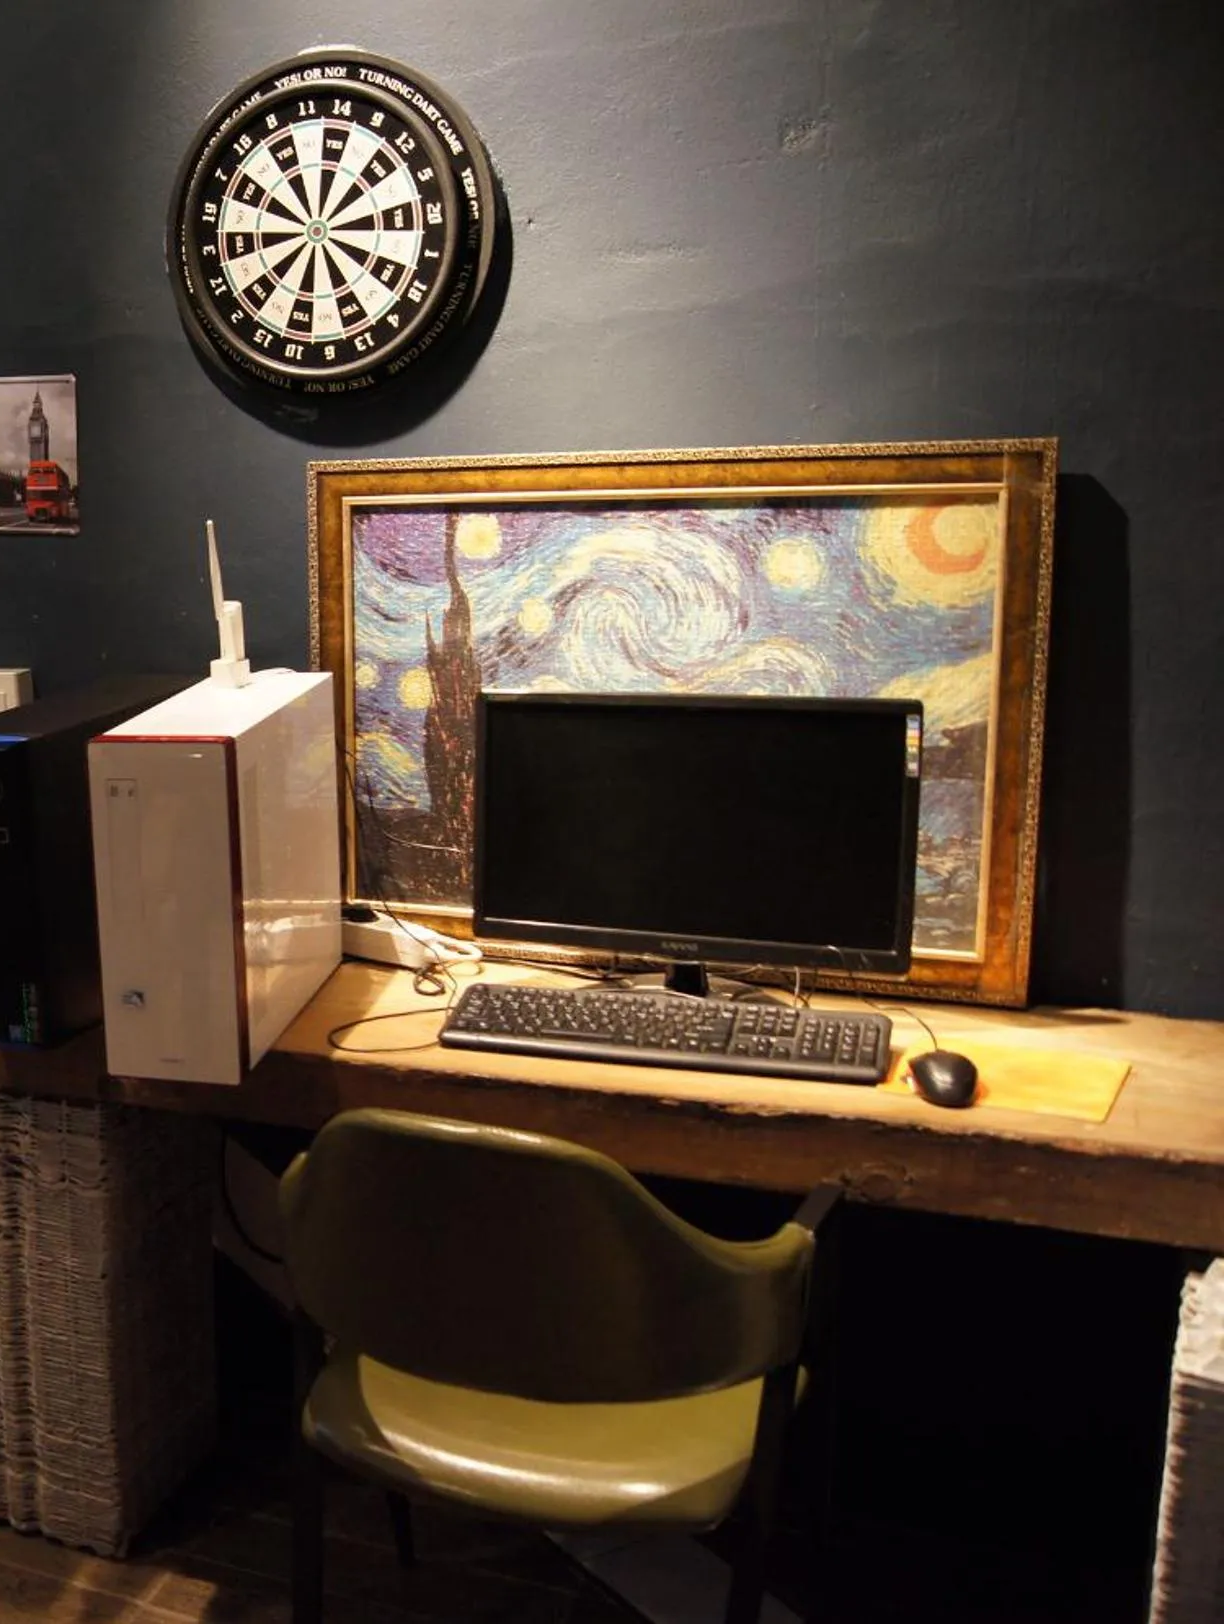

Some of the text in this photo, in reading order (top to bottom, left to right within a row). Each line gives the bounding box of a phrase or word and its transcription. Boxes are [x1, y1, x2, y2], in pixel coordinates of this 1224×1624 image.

[274, 66, 347, 89] YES! OR NO!
[298, 100, 316, 117] 11
[331, 98, 352, 117] 14
[359, 68, 464, 155] TURNING DART GAME
[265, 113, 279, 130] 8
[369, 111, 386, 128] 9
[232, 133, 253, 156] 16
[325, 138, 344, 150] YES
[394, 131, 416, 155] 12
[275, 146, 295, 161] YES
[214, 167, 228, 182] 7
[370, 159, 387, 179] YES
[416, 167, 435, 182] 5
[242, 182, 256, 201] YES
[201, 202, 218, 223] 19
[393, 207, 404, 229] YES
[425, 201, 443, 225] 20
[202, 244, 217, 256] 3
[423, 248, 440, 259] 1
[379, 263, 396, 283] YES
[209, 276, 228, 296] 17
[252, 283, 267, 301] YES
[407, 279, 428, 303] 18
[230, 309, 245, 324] 2
[292, 311, 310, 322] YES
[386, 313, 400, 329] 4
[252, 328, 274, 348] 15
[353, 331, 375, 352] 13
[284, 343, 305, 360] 10
[324, 344, 336, 361] 6
